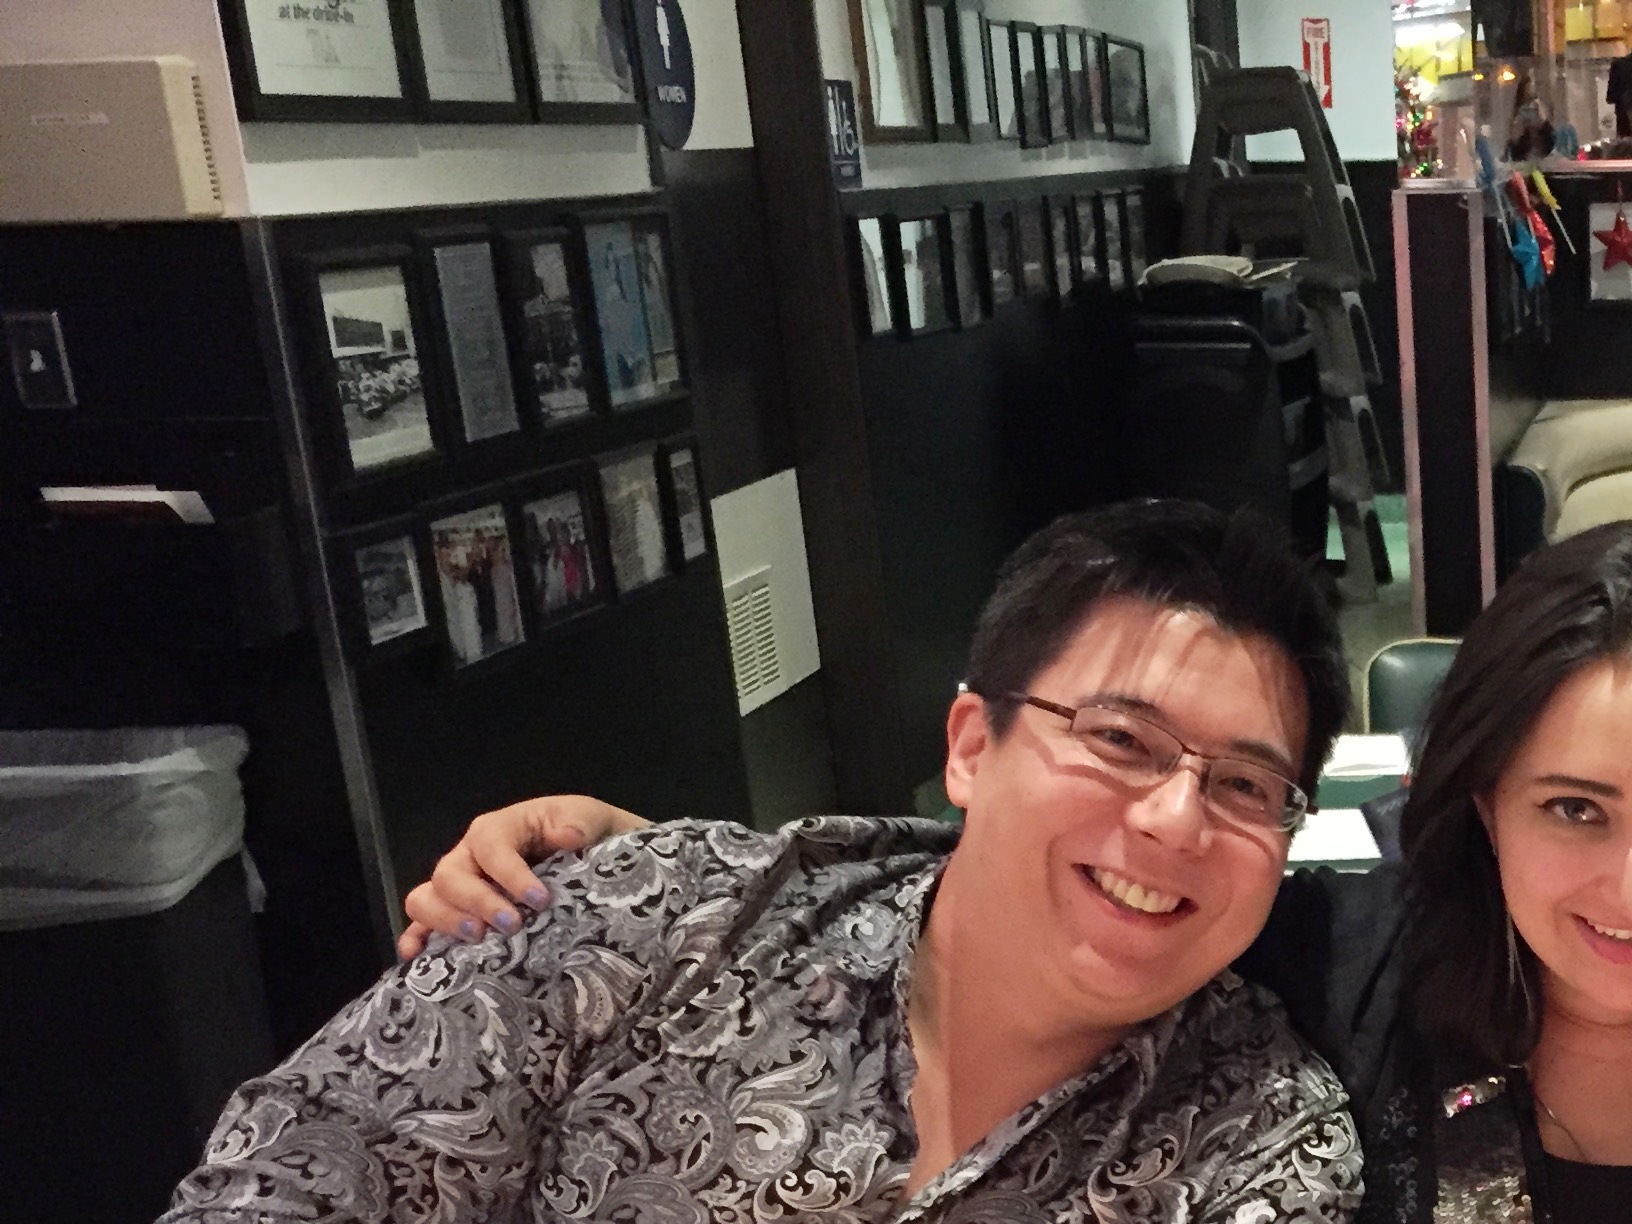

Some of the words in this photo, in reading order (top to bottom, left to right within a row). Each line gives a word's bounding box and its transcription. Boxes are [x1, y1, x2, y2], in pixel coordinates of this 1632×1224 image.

[293, 3, 310, 20] the
[313, 5, 354, 24] drive-in
[1306, 27, 1325, 39] FIRE
[657, 85, 686, 103] WOMEN
